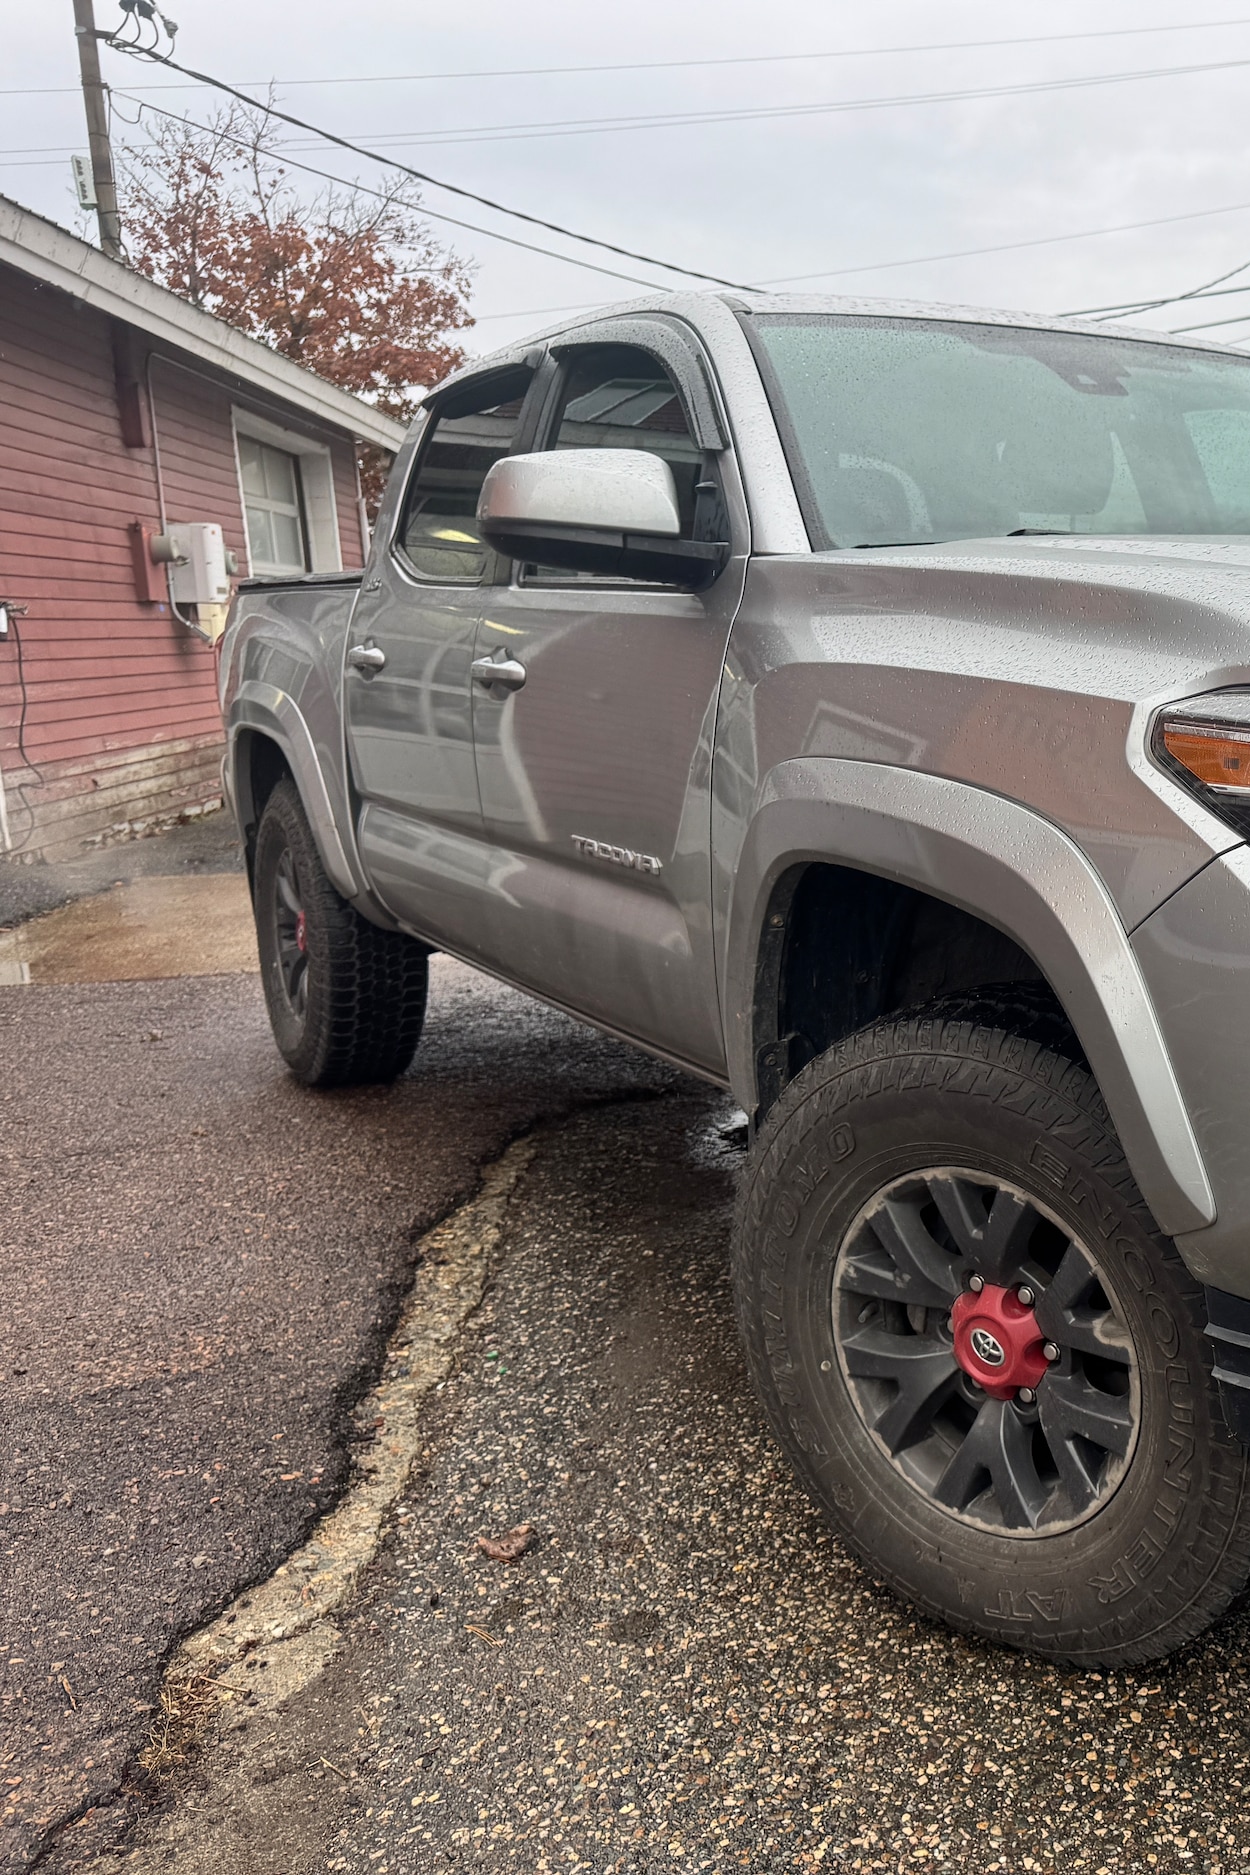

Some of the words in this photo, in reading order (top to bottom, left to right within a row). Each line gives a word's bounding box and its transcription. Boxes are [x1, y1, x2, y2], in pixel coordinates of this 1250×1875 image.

[571, 834, 663, 876] TACOMA
[1029, 1137, 1196, 1604] ENCOUNTER
[984, 1586, 1066, 1622] AT
